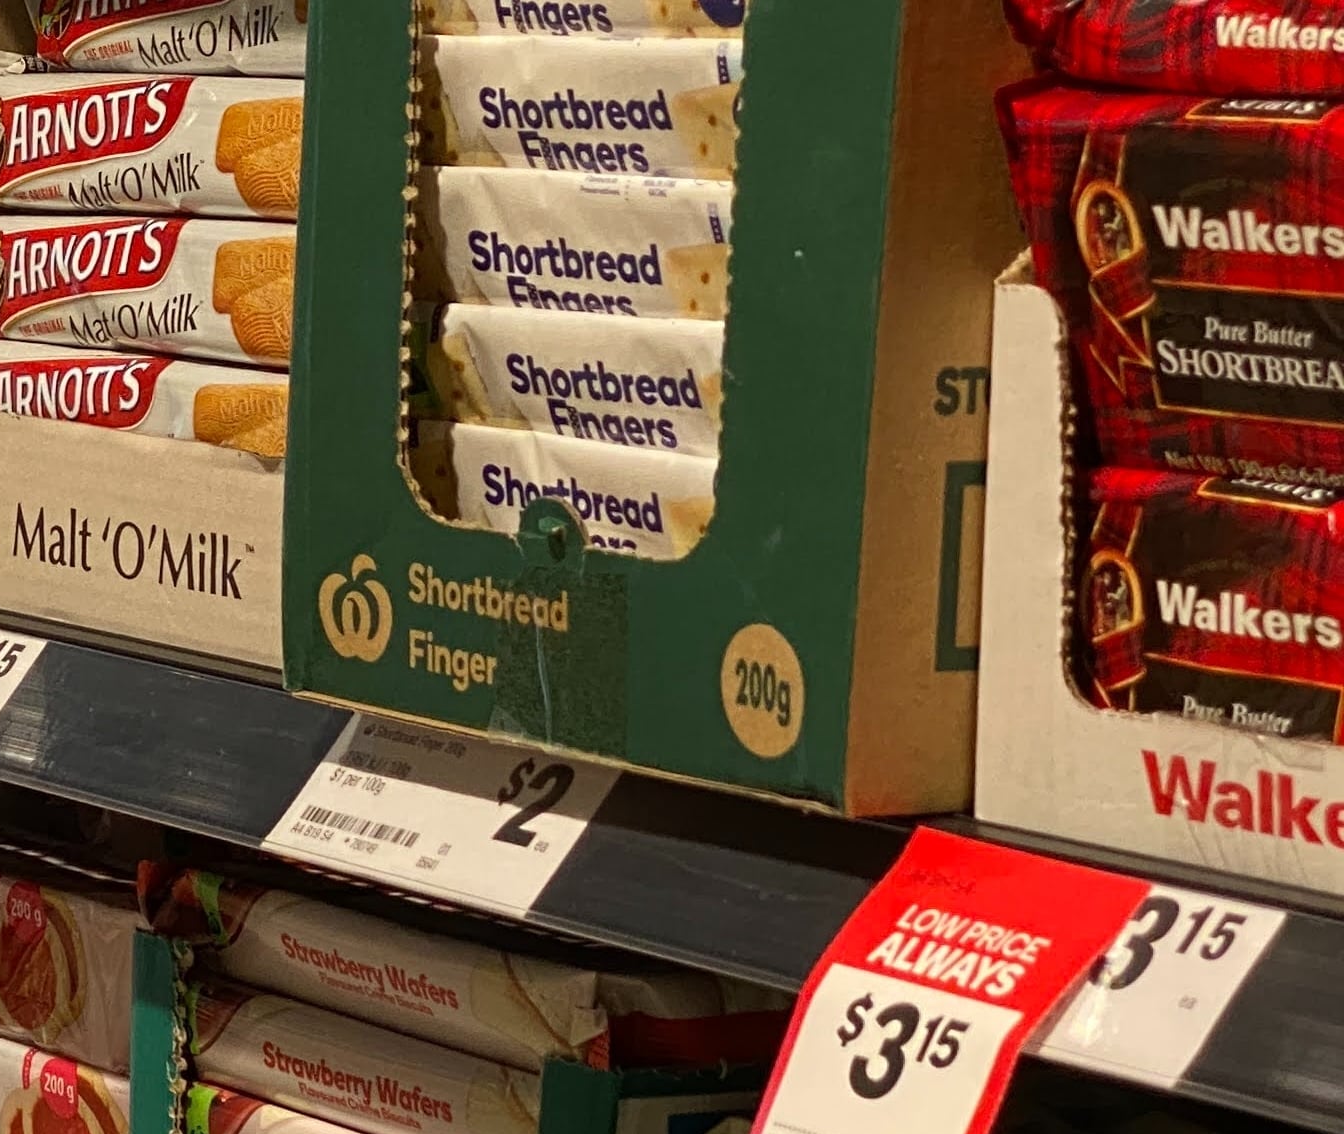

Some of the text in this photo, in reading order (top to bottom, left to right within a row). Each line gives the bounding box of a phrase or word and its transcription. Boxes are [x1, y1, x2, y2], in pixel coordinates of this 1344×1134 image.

[1216, 15, 1344, 51] Walkers
[7, 81, 171, 166] ARNOTT'S
[479, 87, 673, 173] Shortbread Fingers
[8, 220, 169, 300] ARNOTT'S
[468, 230, 662, 285] Shortbread
[1153, 205, 1344, 258] Walkers
[1205, 317, 1313, 348] Pure Butter
[507, 353, 702, 409] Shortbread
[13, 503, 91, 573] Malt
[408, 562, 569, 632] Shortbread
[1157, 579, 1340, 648] Walkers
[408, 629, 497, 691] Finger
[736, 659, 791, 727] 200g
[343, 772, 385, 795] per 100g
[498, 757, 574, 847] $2
[281, 934, 382, 991] Strawberry
[868, 932, 1026, 997] ALWAYS
[897, 904, 1051, 963] LOW PRICE
[263, 1041, 373, 1105] Strawberry
